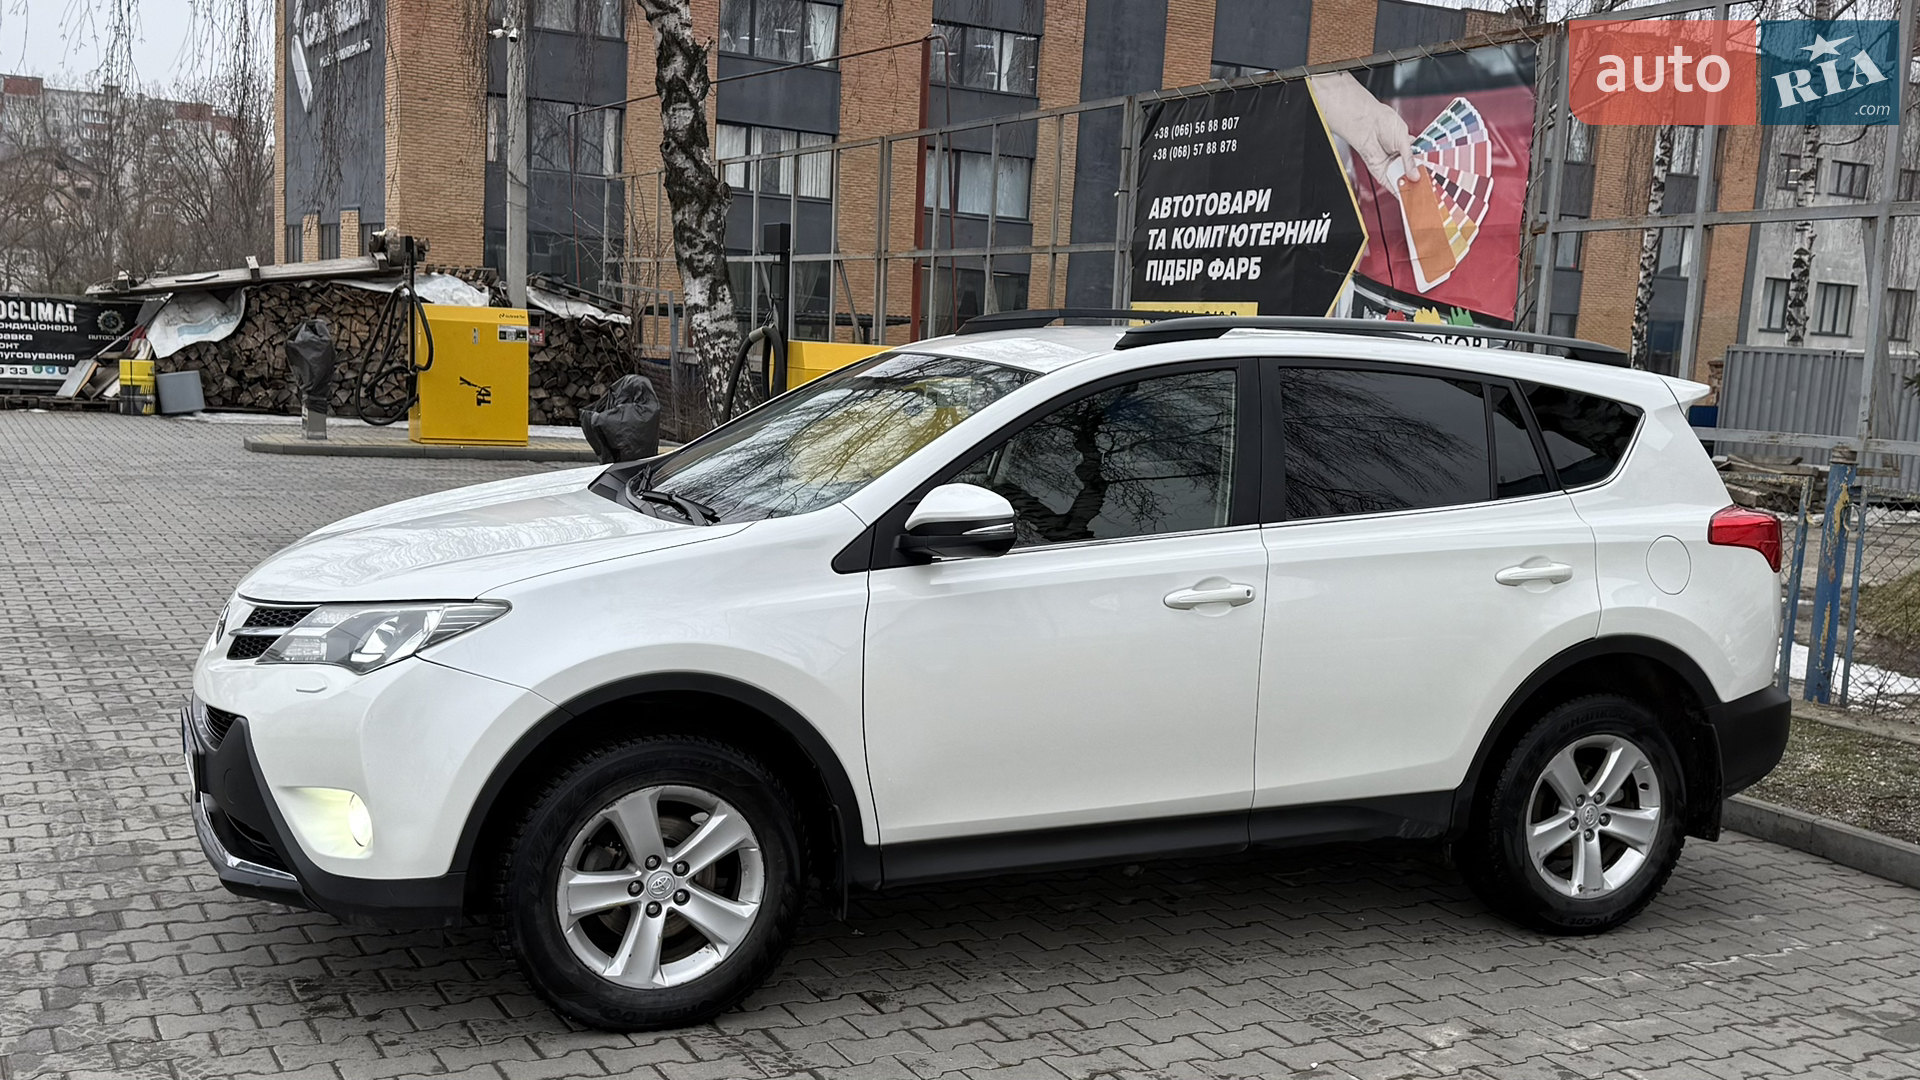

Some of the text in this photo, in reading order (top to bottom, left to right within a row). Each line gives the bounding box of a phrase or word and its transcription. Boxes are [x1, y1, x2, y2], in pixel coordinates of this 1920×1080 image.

[1154, 116, 1240, 140] +38 (066) 56 88 807
[1152, 139, 1237, 161] +38 (068) 57 88 878
[1148, 188, 1272, 219] АВТОТОВАРИ
[1148, 212, 1332, 250] ТА КОМП'ЮТЕРНИЙ
[1145, 256, 1262, 286] ПІДБІР ФАРБ
[9, 367, 28, 375] 33
